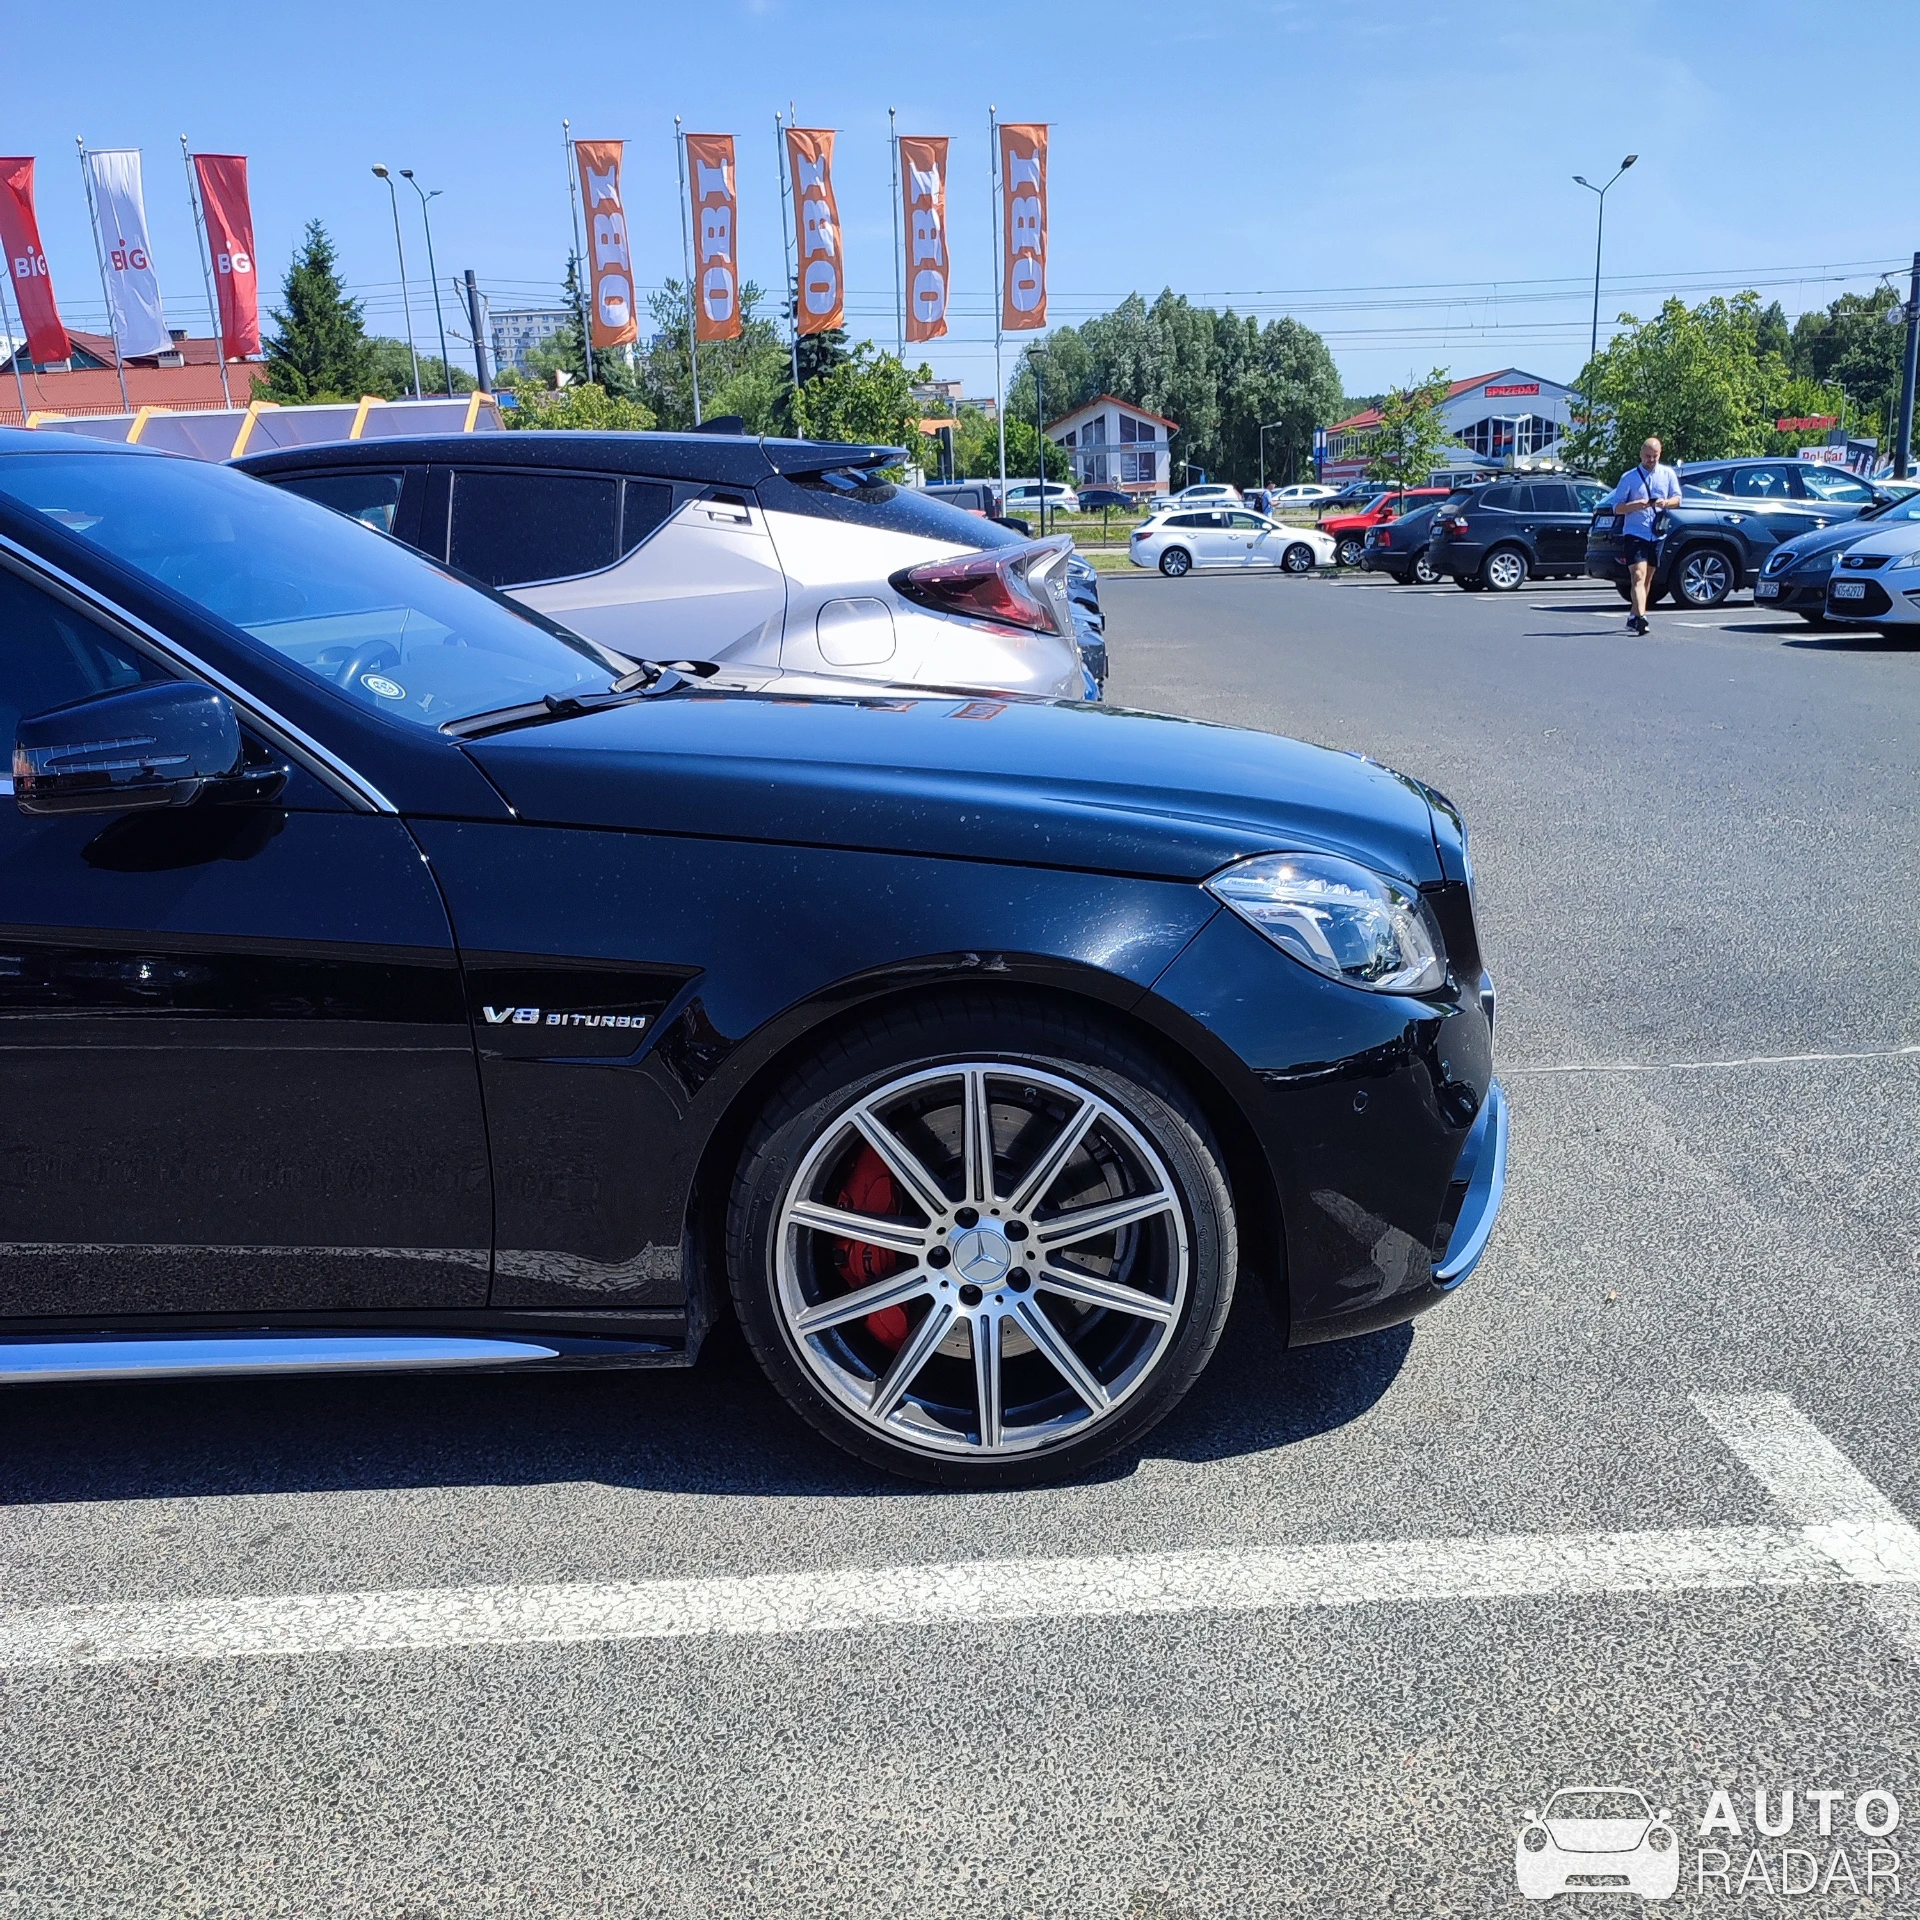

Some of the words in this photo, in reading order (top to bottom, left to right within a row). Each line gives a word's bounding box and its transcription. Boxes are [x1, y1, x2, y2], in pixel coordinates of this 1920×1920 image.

[14, 245, 48, 279] BIG
[110, 238, 148, 272] BIG
[586, 165, 631, 328] OBI
[696, 158, 735, 322] OBI
[797, 153, 836, 316] OBI
[909, 161, 945, 324] OBI
[1009, 149, 1043, 313] OBI
[482, 1006, 540, 1024] V8
[545, 1013, 646, 1029] BITURBO
